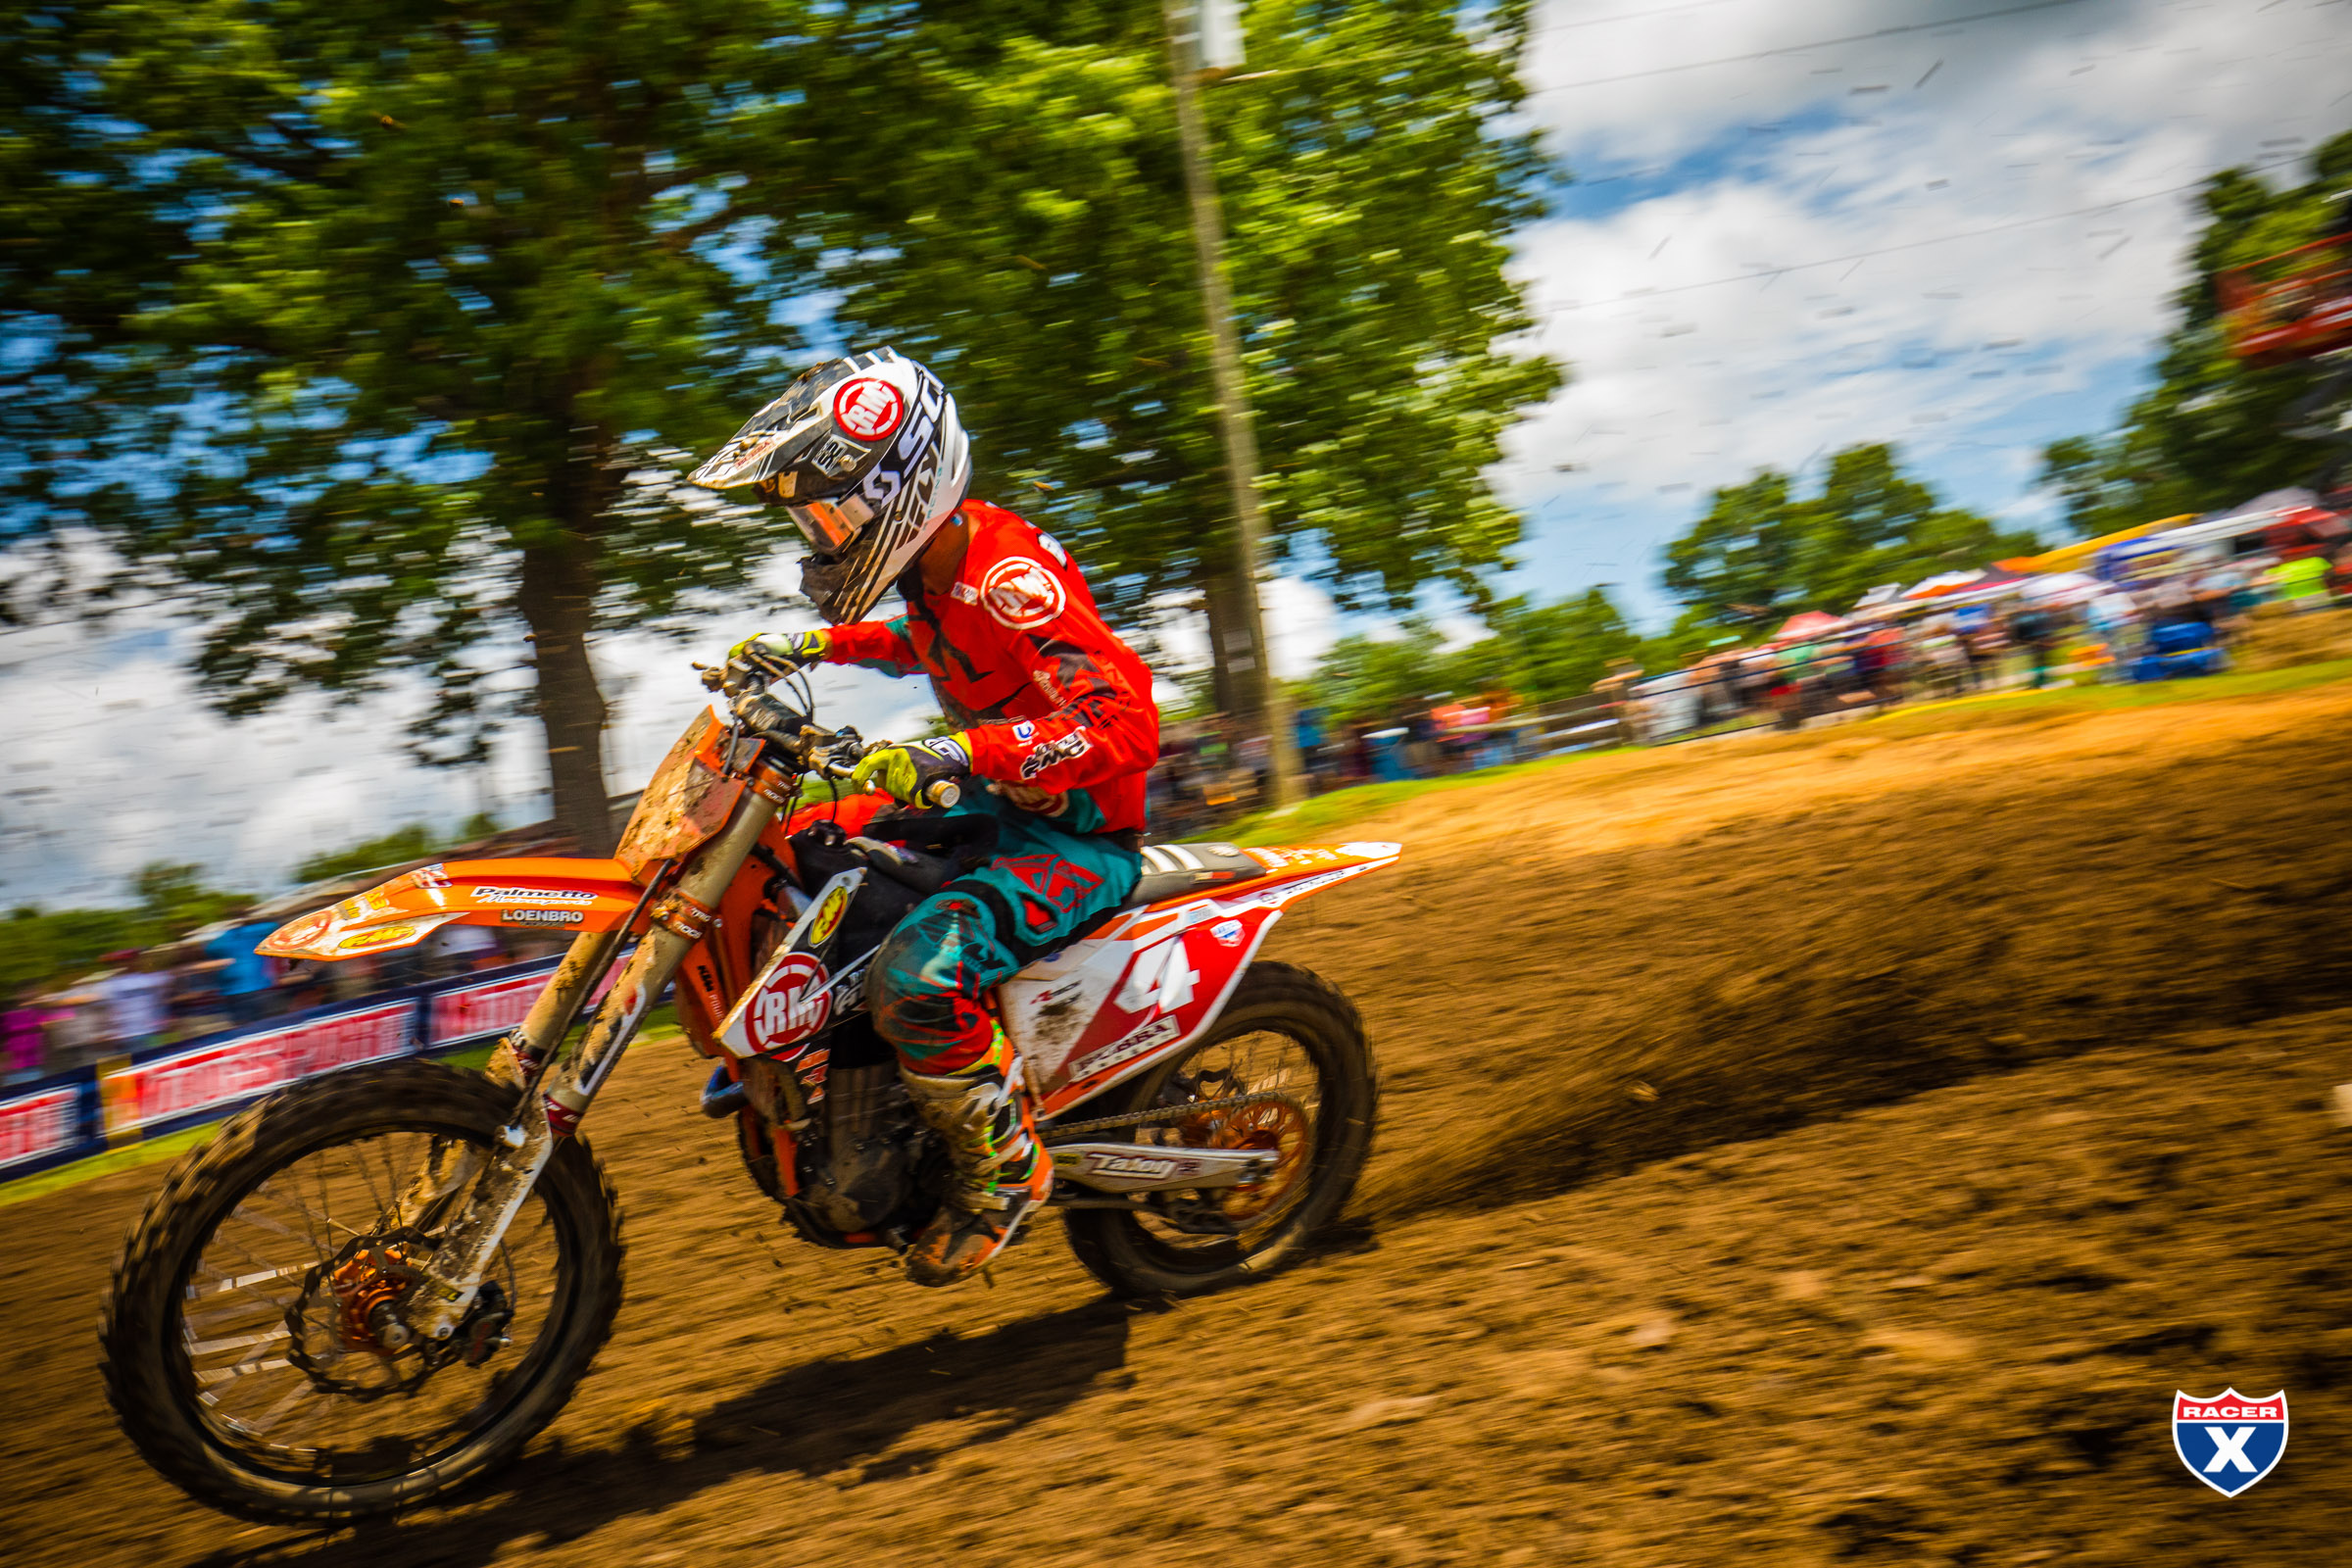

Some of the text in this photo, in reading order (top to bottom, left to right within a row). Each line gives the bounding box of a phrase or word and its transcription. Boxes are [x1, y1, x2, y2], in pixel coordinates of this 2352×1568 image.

[473, 886, 598, 900] Palmetto
[501, 909, 584, 922] LOENBRO
[339, 926, 414, 949] FMF
[1114, 936, 1200, 1014] 4
[1088, 1152, 1177, 1179] Talon
